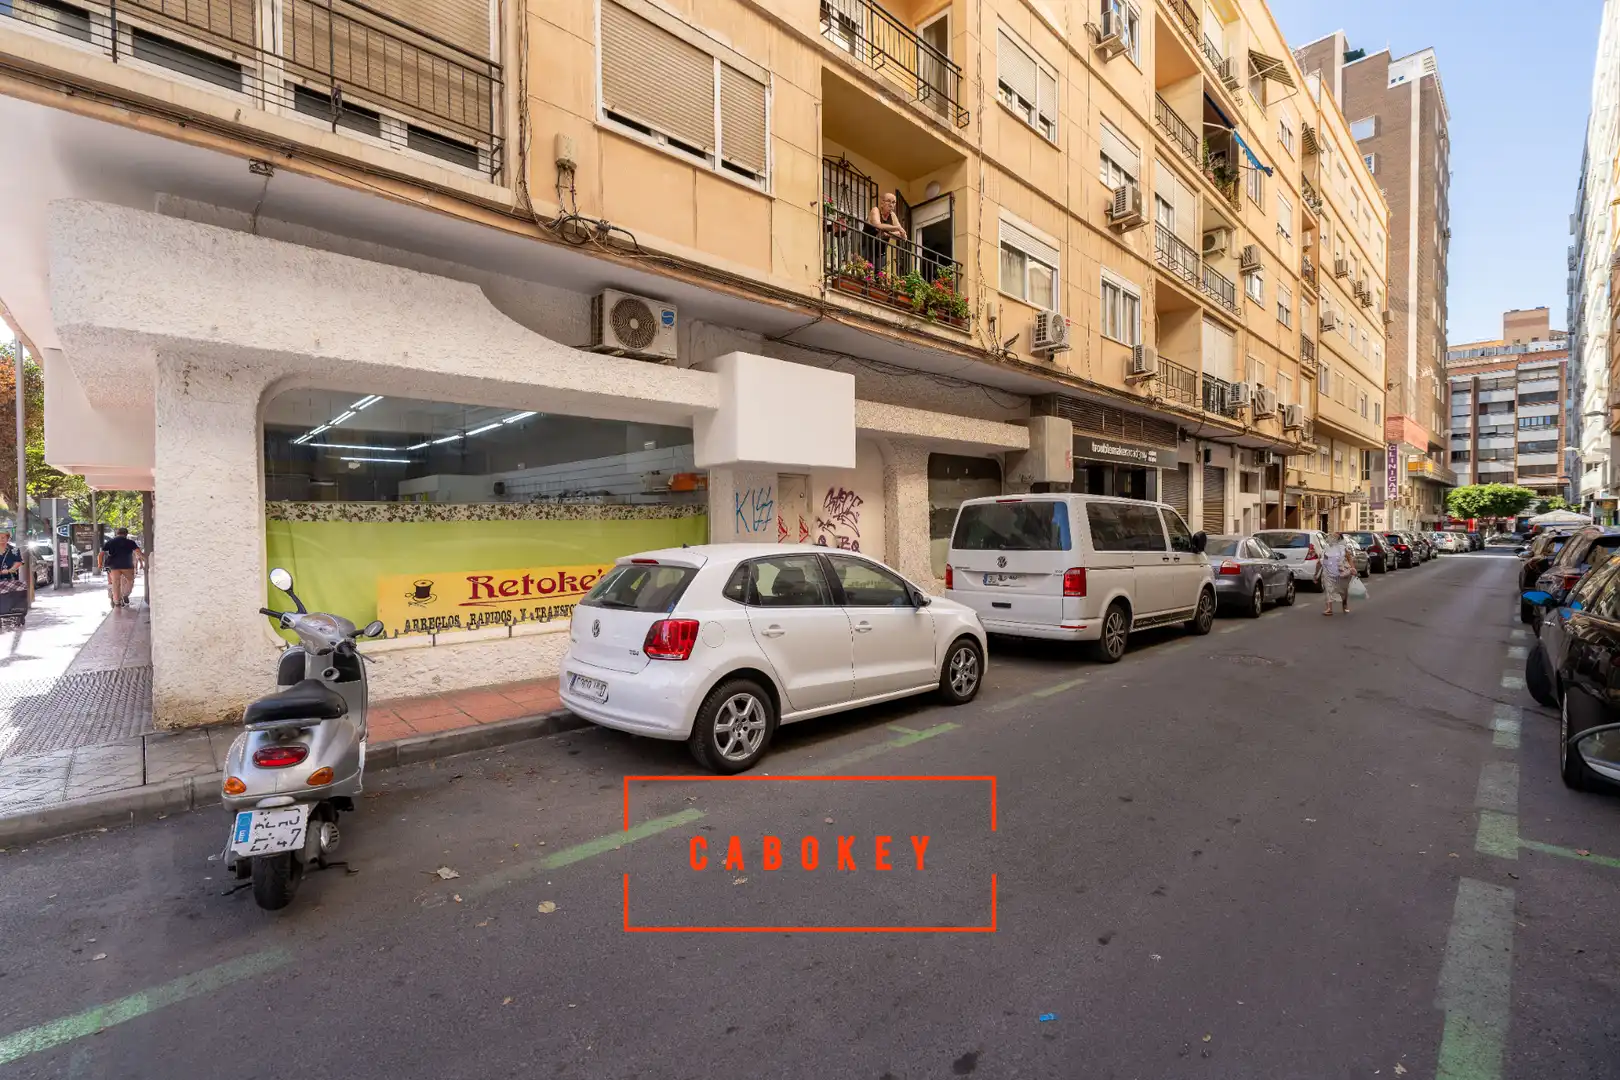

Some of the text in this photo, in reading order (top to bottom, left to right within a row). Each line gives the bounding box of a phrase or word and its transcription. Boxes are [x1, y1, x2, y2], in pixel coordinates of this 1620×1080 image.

[466, 569, 606, 599] Retoke'
[404, 614, 460, 634] ARREGLOS
[469, 609, 512, 626] RAPIDOS
